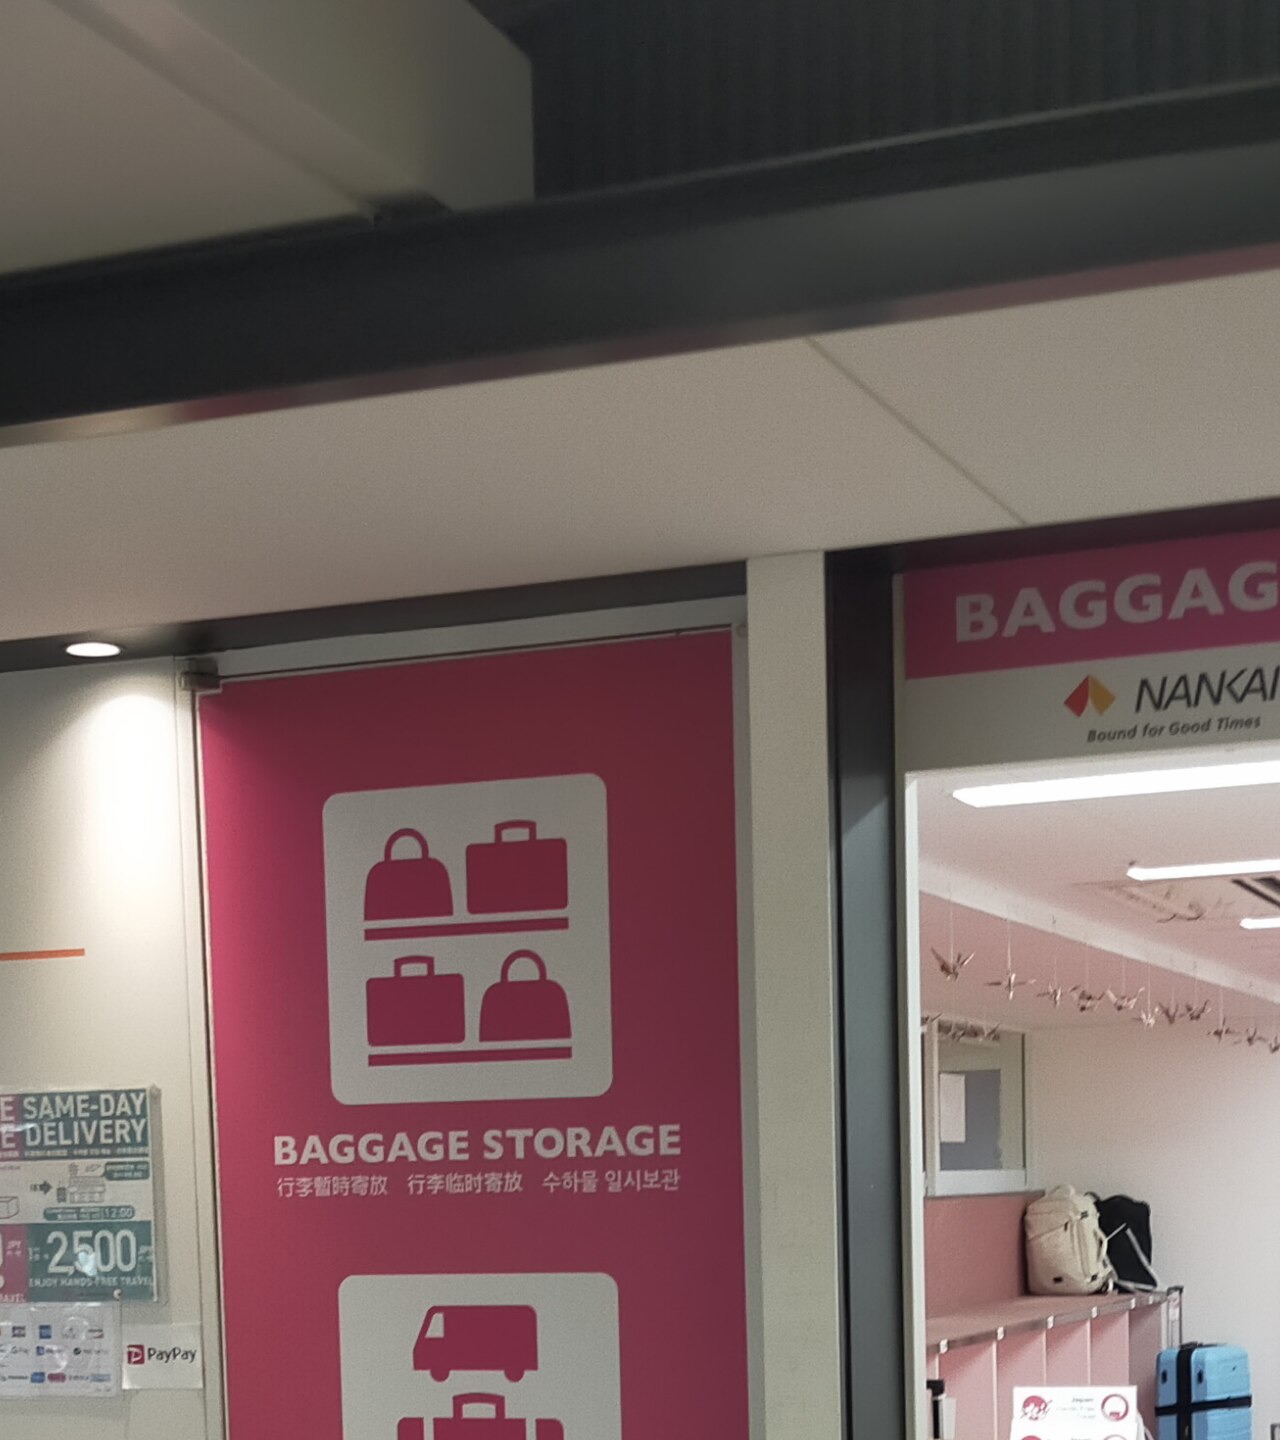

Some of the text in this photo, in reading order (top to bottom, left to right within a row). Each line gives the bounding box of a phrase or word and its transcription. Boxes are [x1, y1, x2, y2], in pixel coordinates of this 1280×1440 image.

[1087, 715, 1261, 743] Bound for Good Times
[23, 1092, 146, 1120] SAME-DAY
[25, 1118, 147, 1147] DELIVERY
[274, 1124, 681, 1165] BAGGAGE STORAGE
[542, 1170, 599, 1194] 수하물
[604, 1168, 680, 1192] 일시보관
[147, 1347, 197, 1363] PayPay
